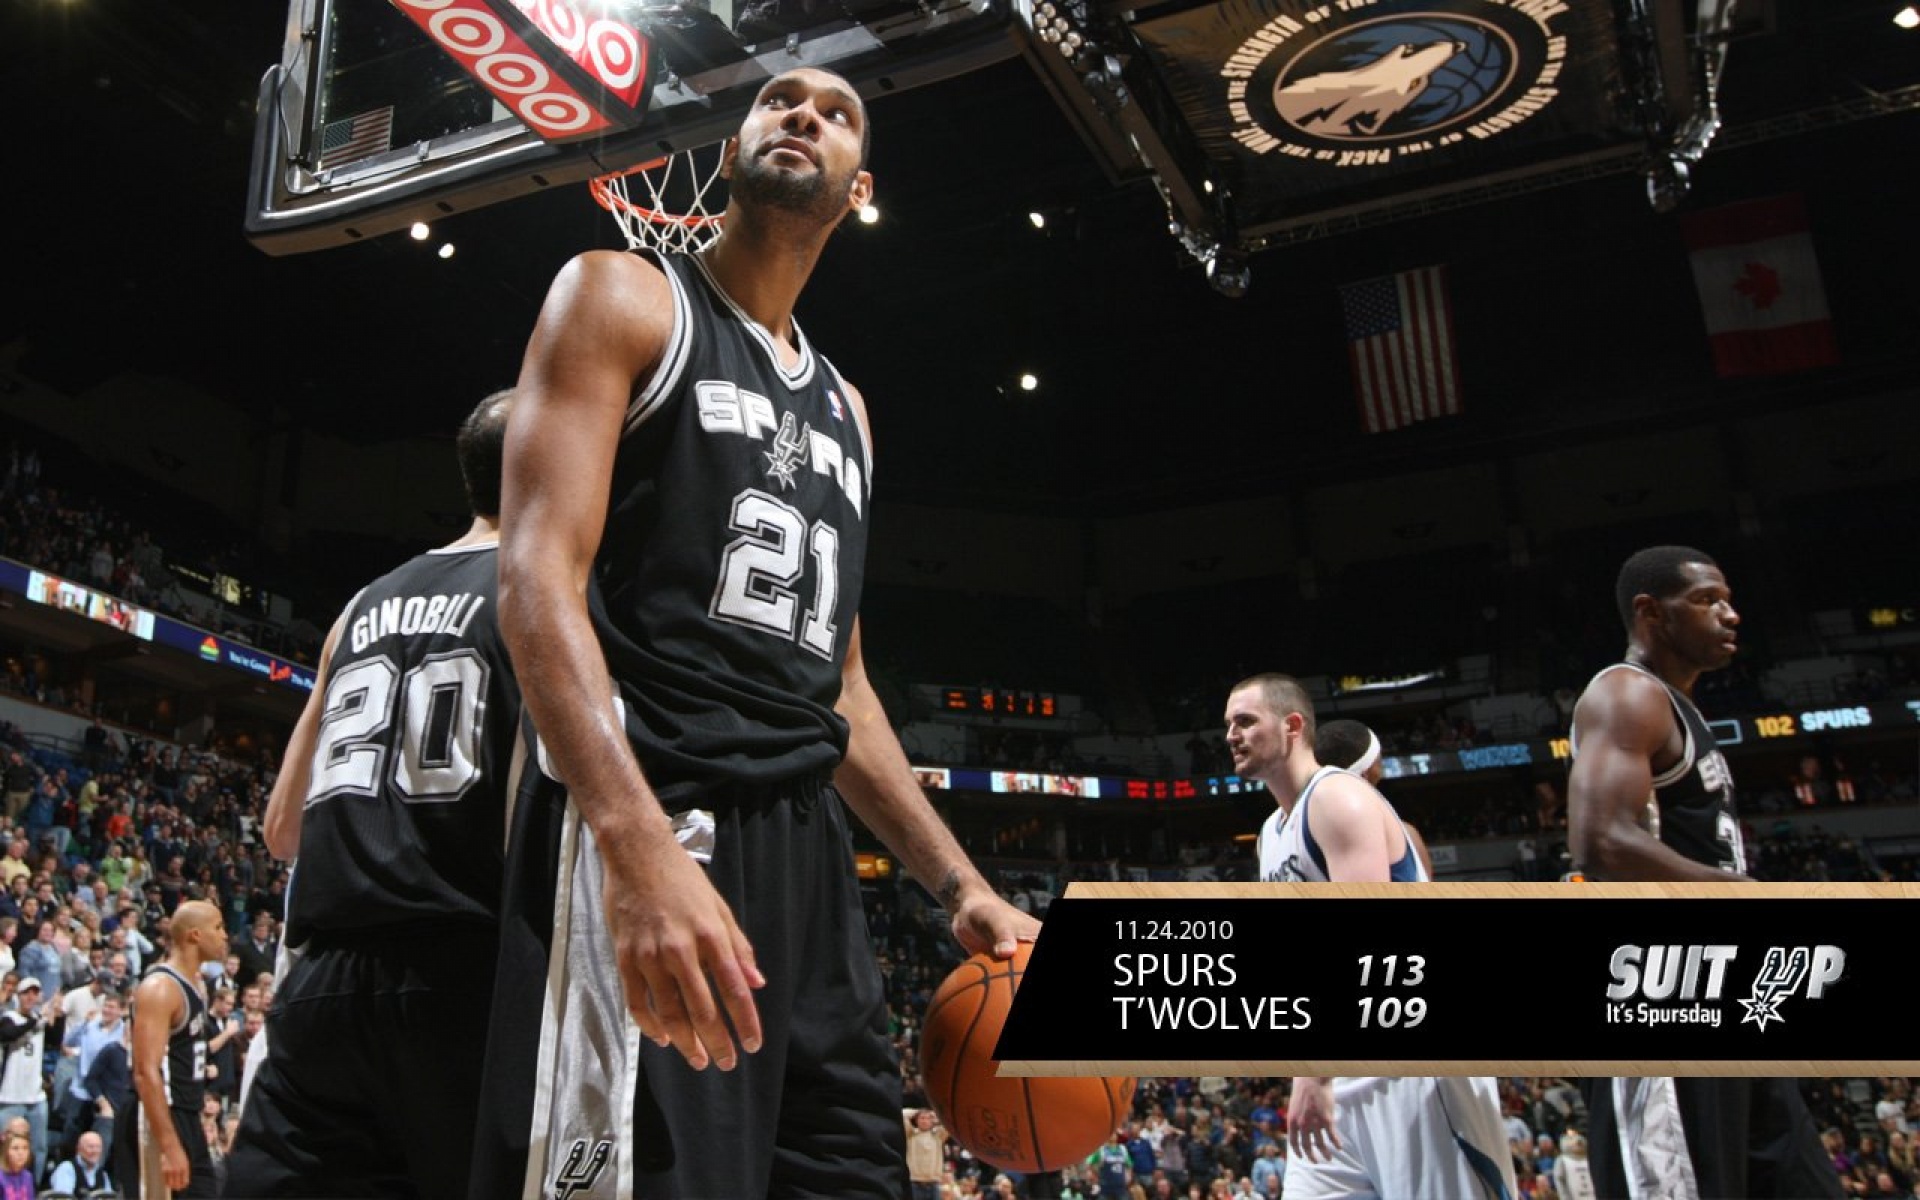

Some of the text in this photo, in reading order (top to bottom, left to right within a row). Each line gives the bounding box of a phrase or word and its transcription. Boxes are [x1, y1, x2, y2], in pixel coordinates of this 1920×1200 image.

[1220, 14, 1305, 79] STRENGTH
[1304, 5, 1331, 23] OF
[1439, 131, 1464, 146] OF
[1466, 86, 1560, 140] STRENGTH
[1335, 146, 1392, 167] PACK
[707, 487, 840, 663] 21
[350, 592, 487, 654] GINOBILI
[301, 648, 492, 810] 20
[1548, 738, 1571, 759] 10
[1755, 706, 1873, 738] 102 SPURS
